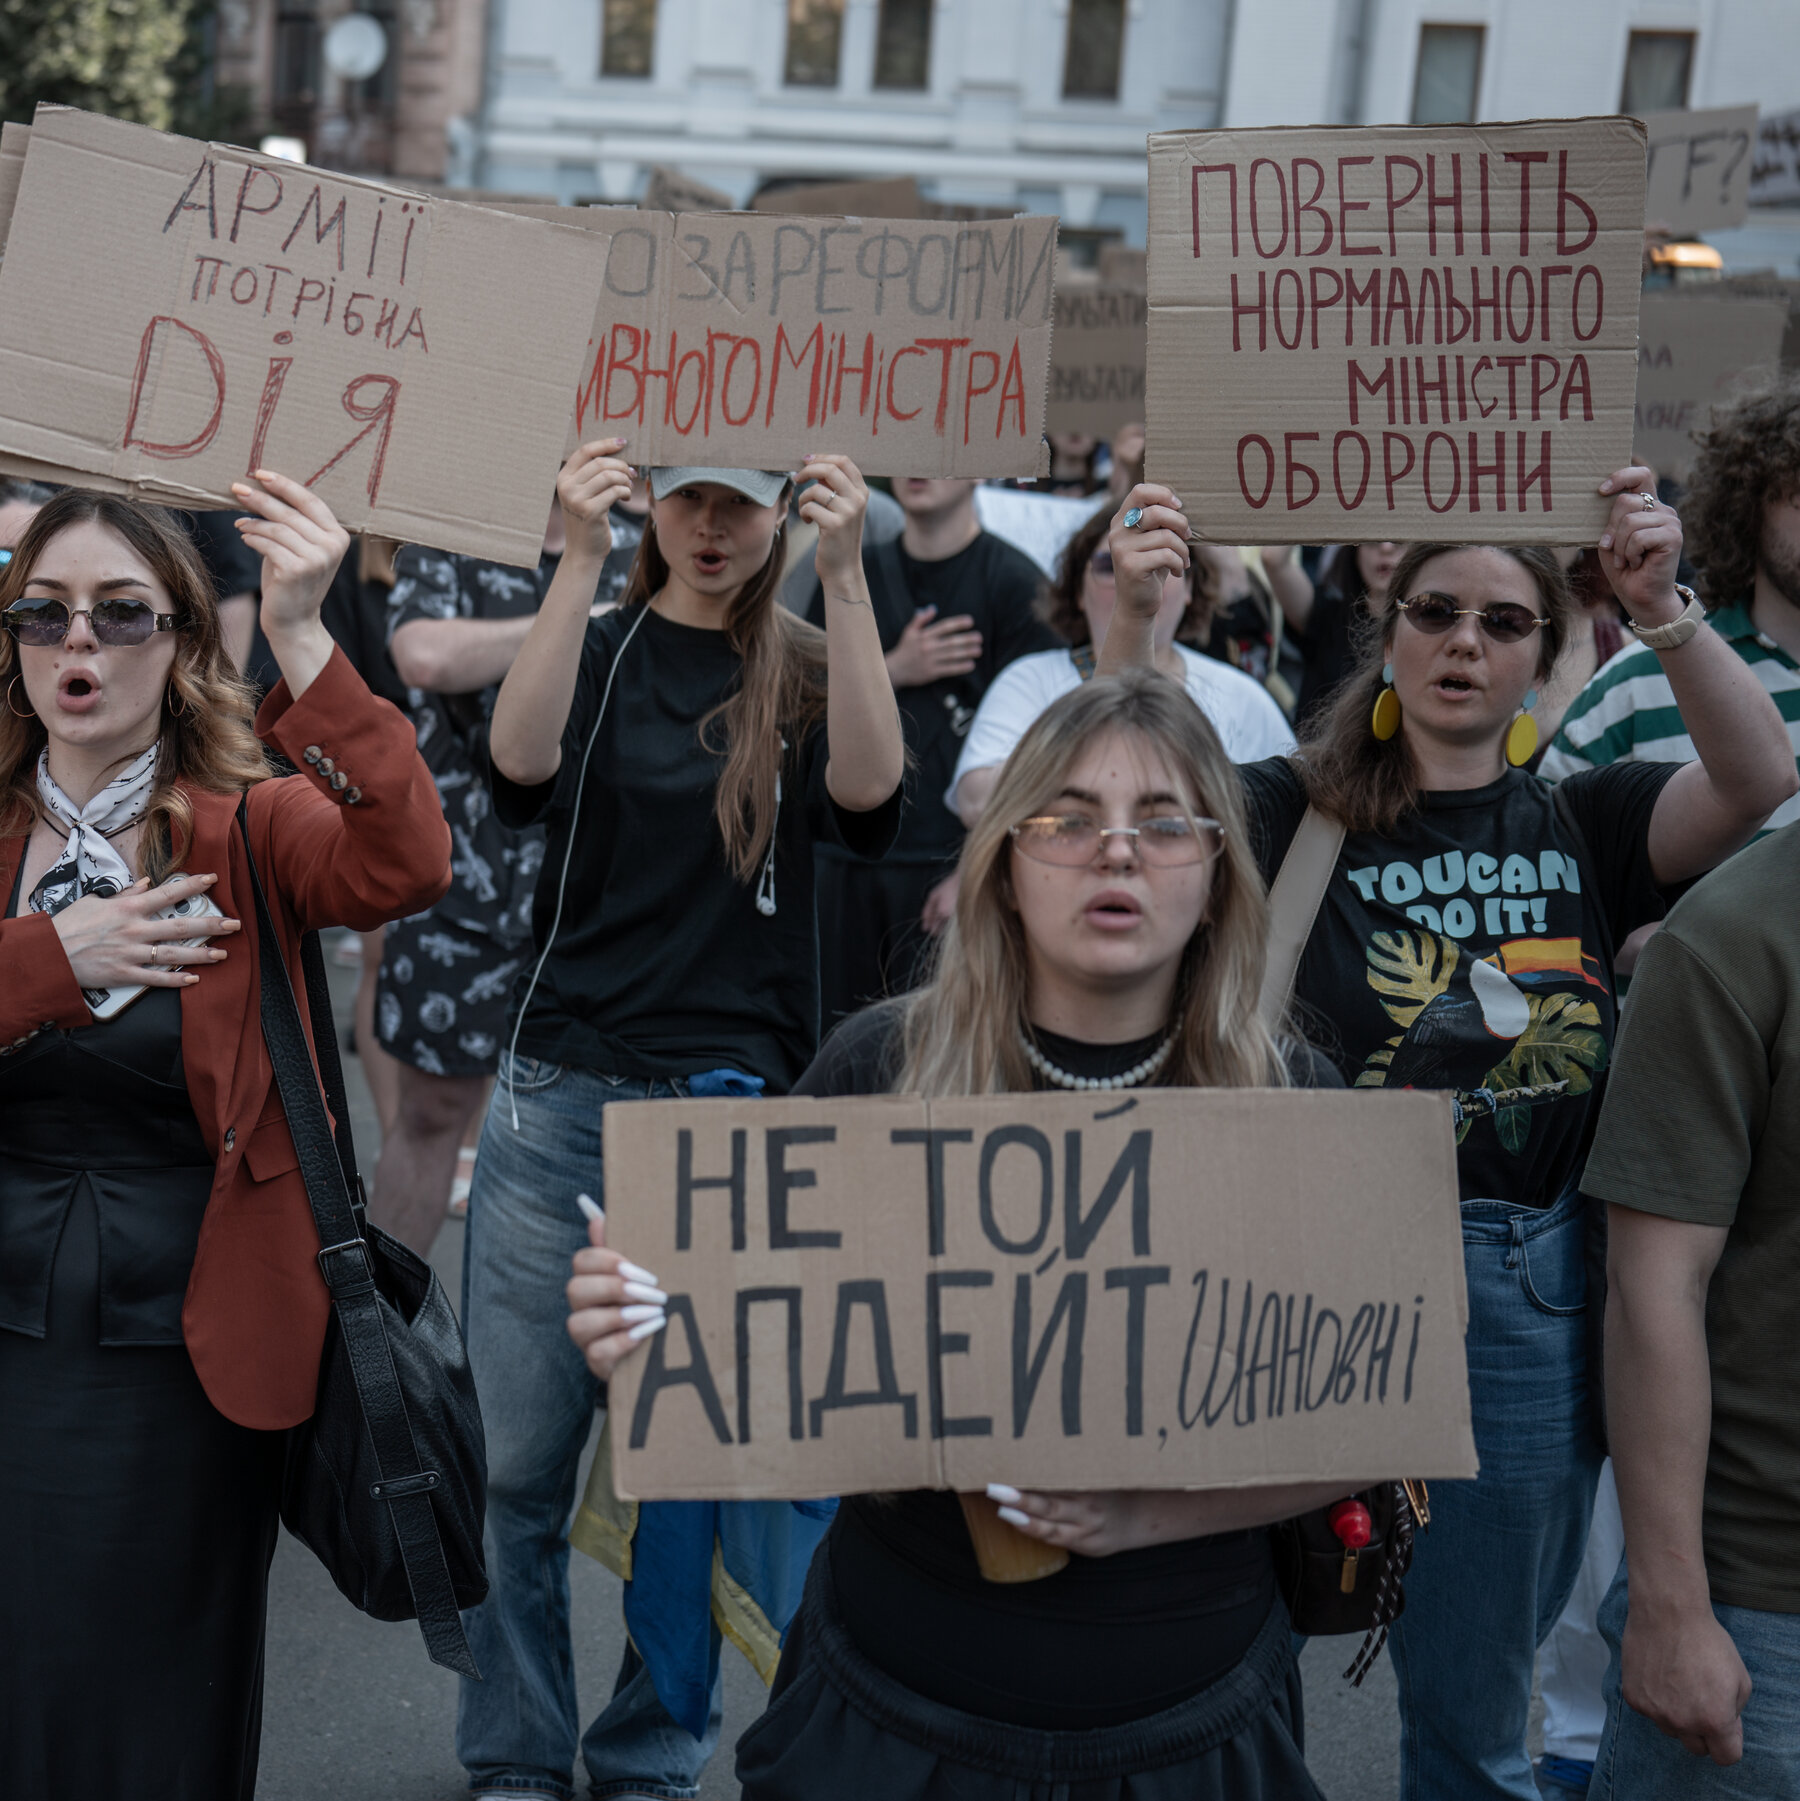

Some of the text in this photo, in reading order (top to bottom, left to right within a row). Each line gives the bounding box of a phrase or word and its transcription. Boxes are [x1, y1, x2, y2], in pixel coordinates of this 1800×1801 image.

[1190, 149, 1599, 259] ПОВЕРНІТЬ
[766, 222, 1058, 322] РЕФОРМИ
[1230, 264, 1605, 352] НОРМАЛЬНОГО
[1347, 353, 1595, 426] МІНІСТРА
[1236, 430, 1553, 514] ОБОРОНИ
[1347, 849, 1582, 905] TOUCAN
[1483, 896, 1548, 936] IT!
[675, 1099, 1153, 1260] НЕ ТОЙ
[628, 1246, 1171, 1450] АПДЕЙТ,
